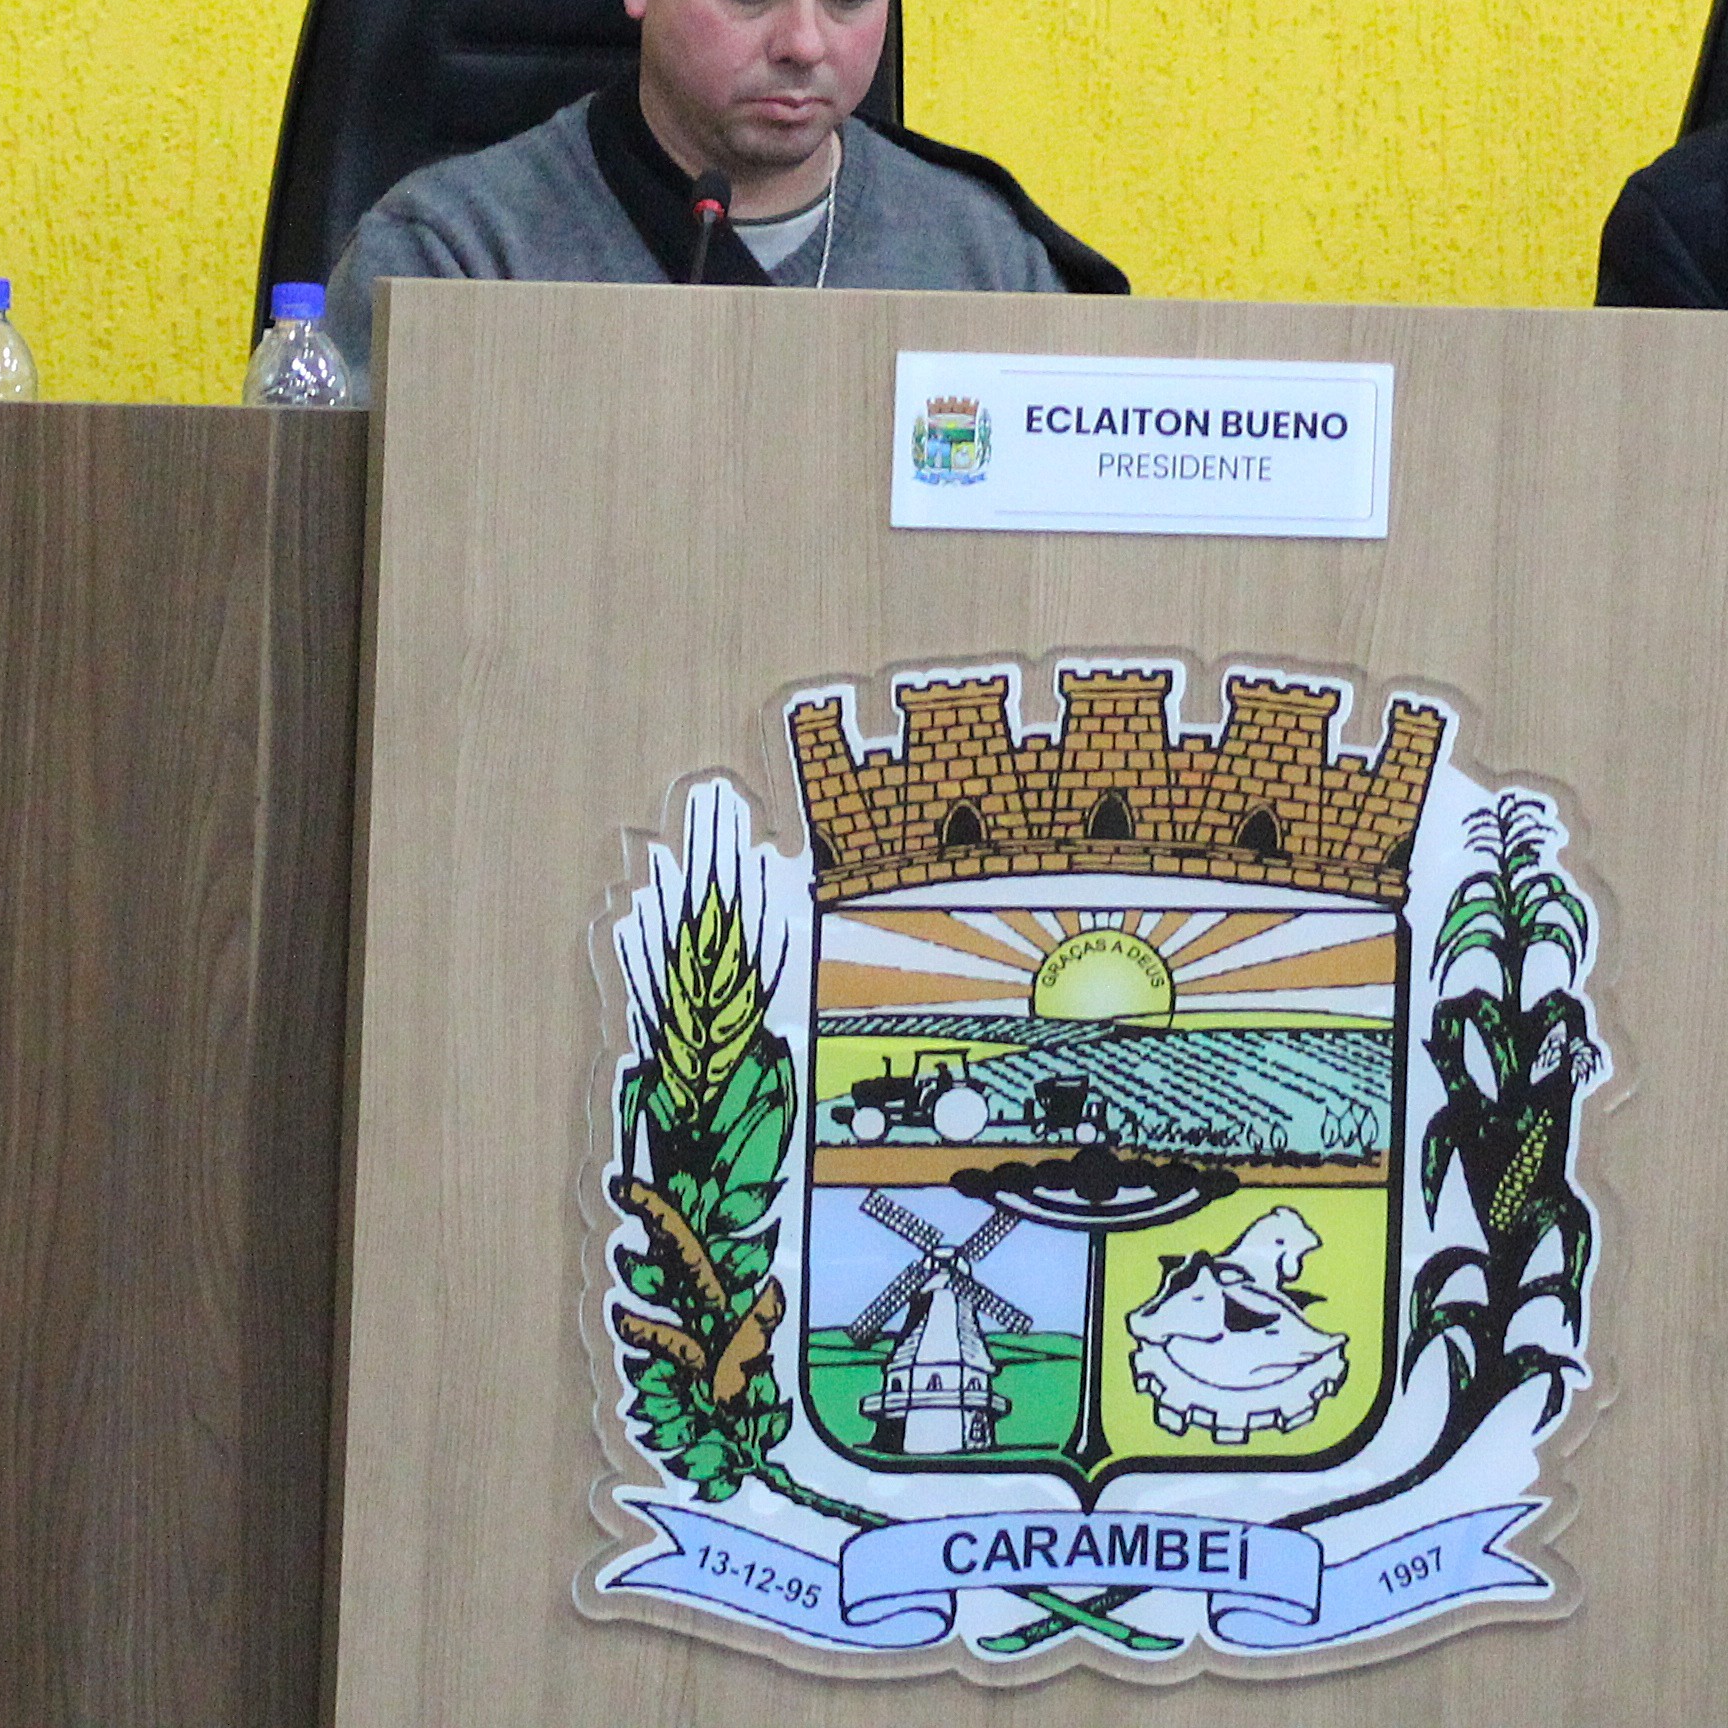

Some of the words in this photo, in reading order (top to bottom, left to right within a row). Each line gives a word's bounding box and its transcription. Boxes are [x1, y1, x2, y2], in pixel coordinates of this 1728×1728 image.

[1026, 405, 1210, 437] ECLAITON
[1222, 410, 1348, 440] BUENO
[1098, 453, 1272, 482] PRESIDENTE
[1111, 940, 1123, 953] A
[1127, 945, 1165, 988] DEUS
[698, 1545, 822, 1609] 13-12-95
[1378, 1544, 1441, 1594] 1997
